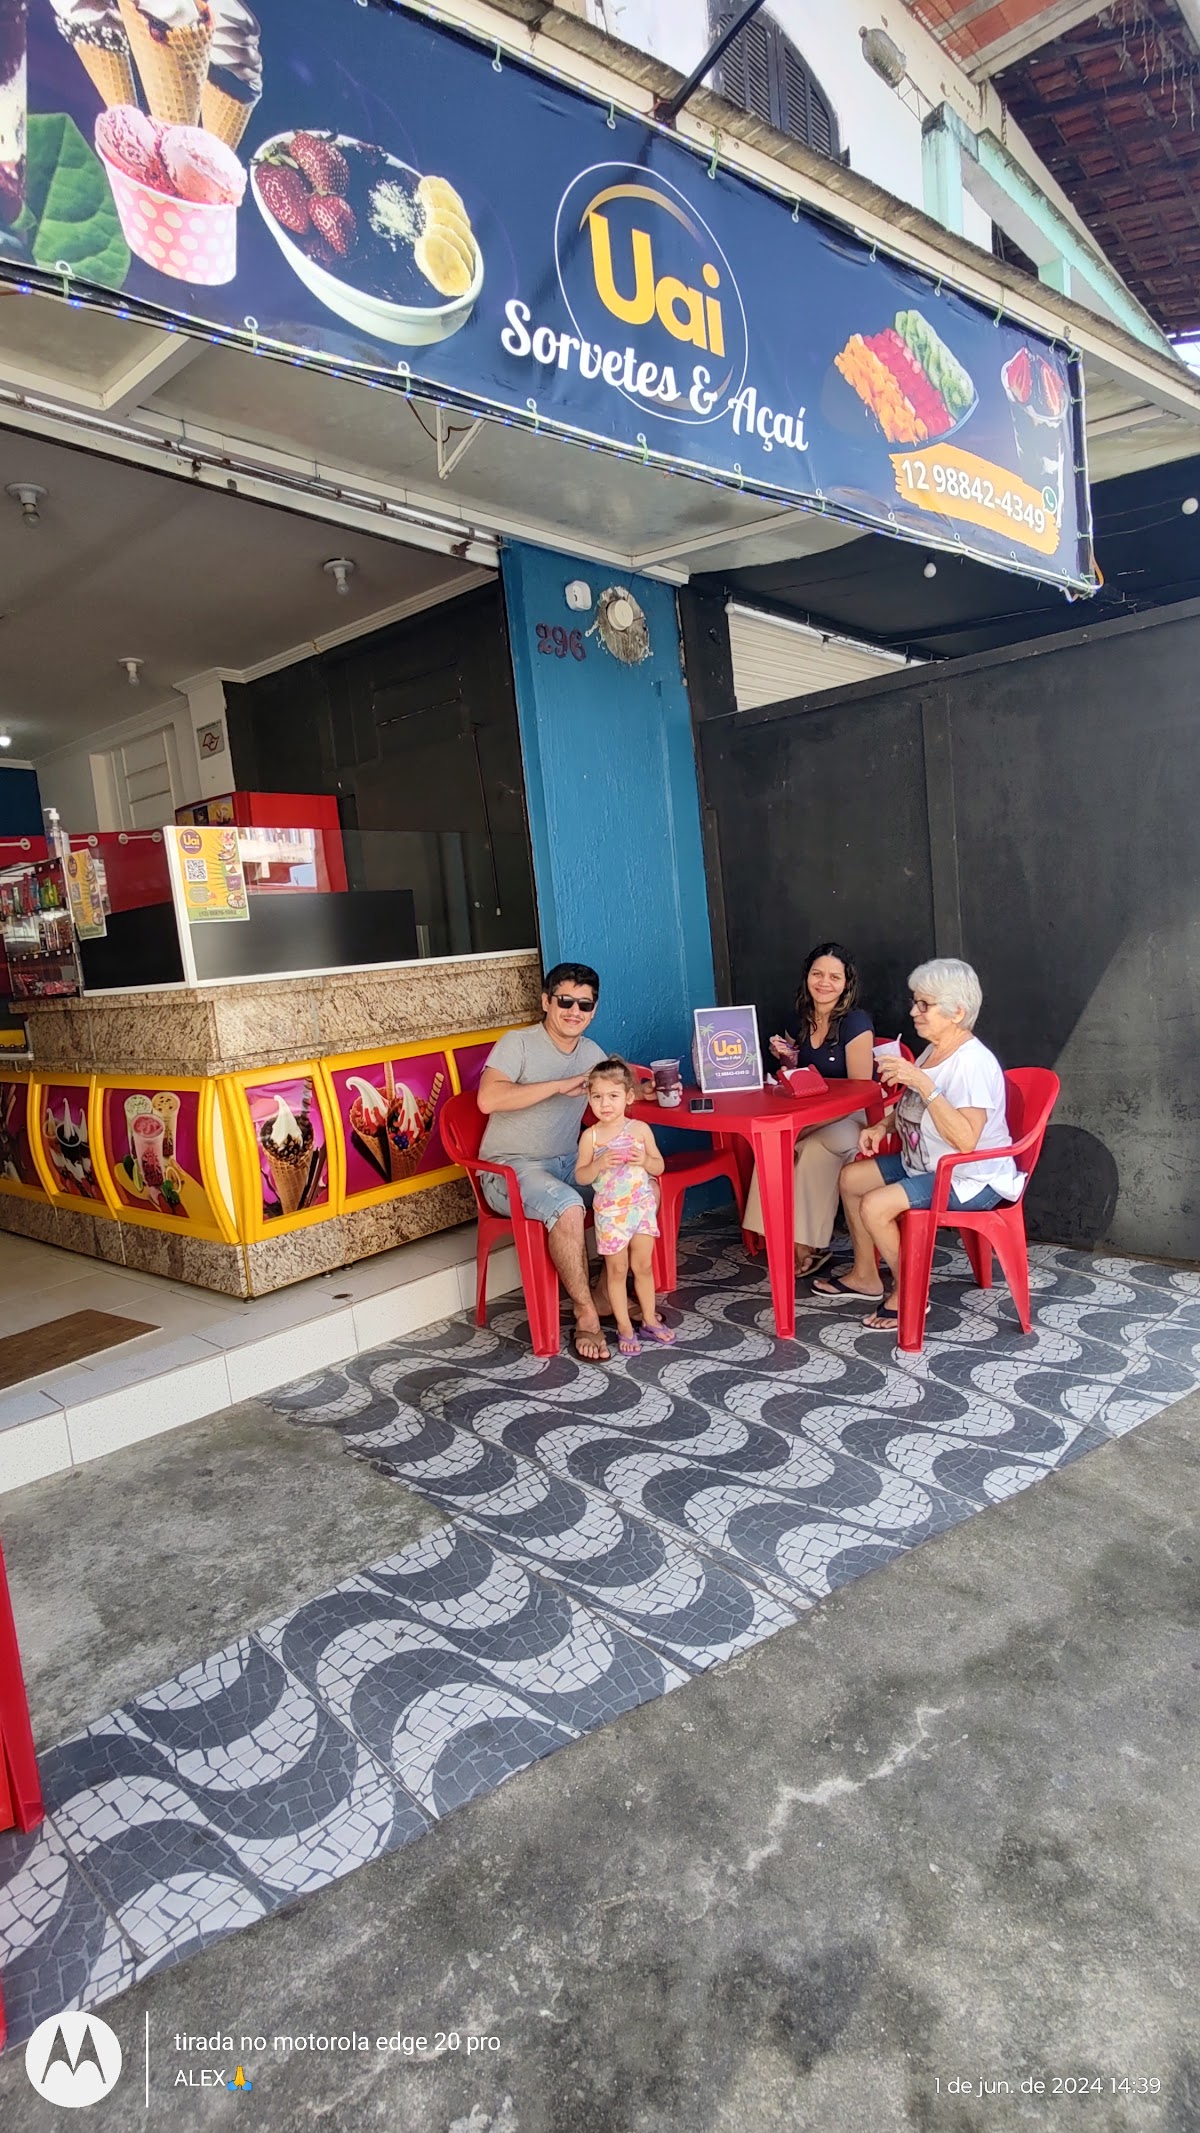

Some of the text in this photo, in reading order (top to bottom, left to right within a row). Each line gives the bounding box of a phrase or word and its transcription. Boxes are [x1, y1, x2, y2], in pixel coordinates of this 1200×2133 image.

[589, 211, 726, 358] Uai
[500, 298, 809, 452] Sorvetes & Açaí
[901, 459, 1045, 534] 12 98842-4349
[535, 622, 587, 662] 296
[183, 834, 200, 846] Uai
[713, 1038, 743, 1057] Uai
